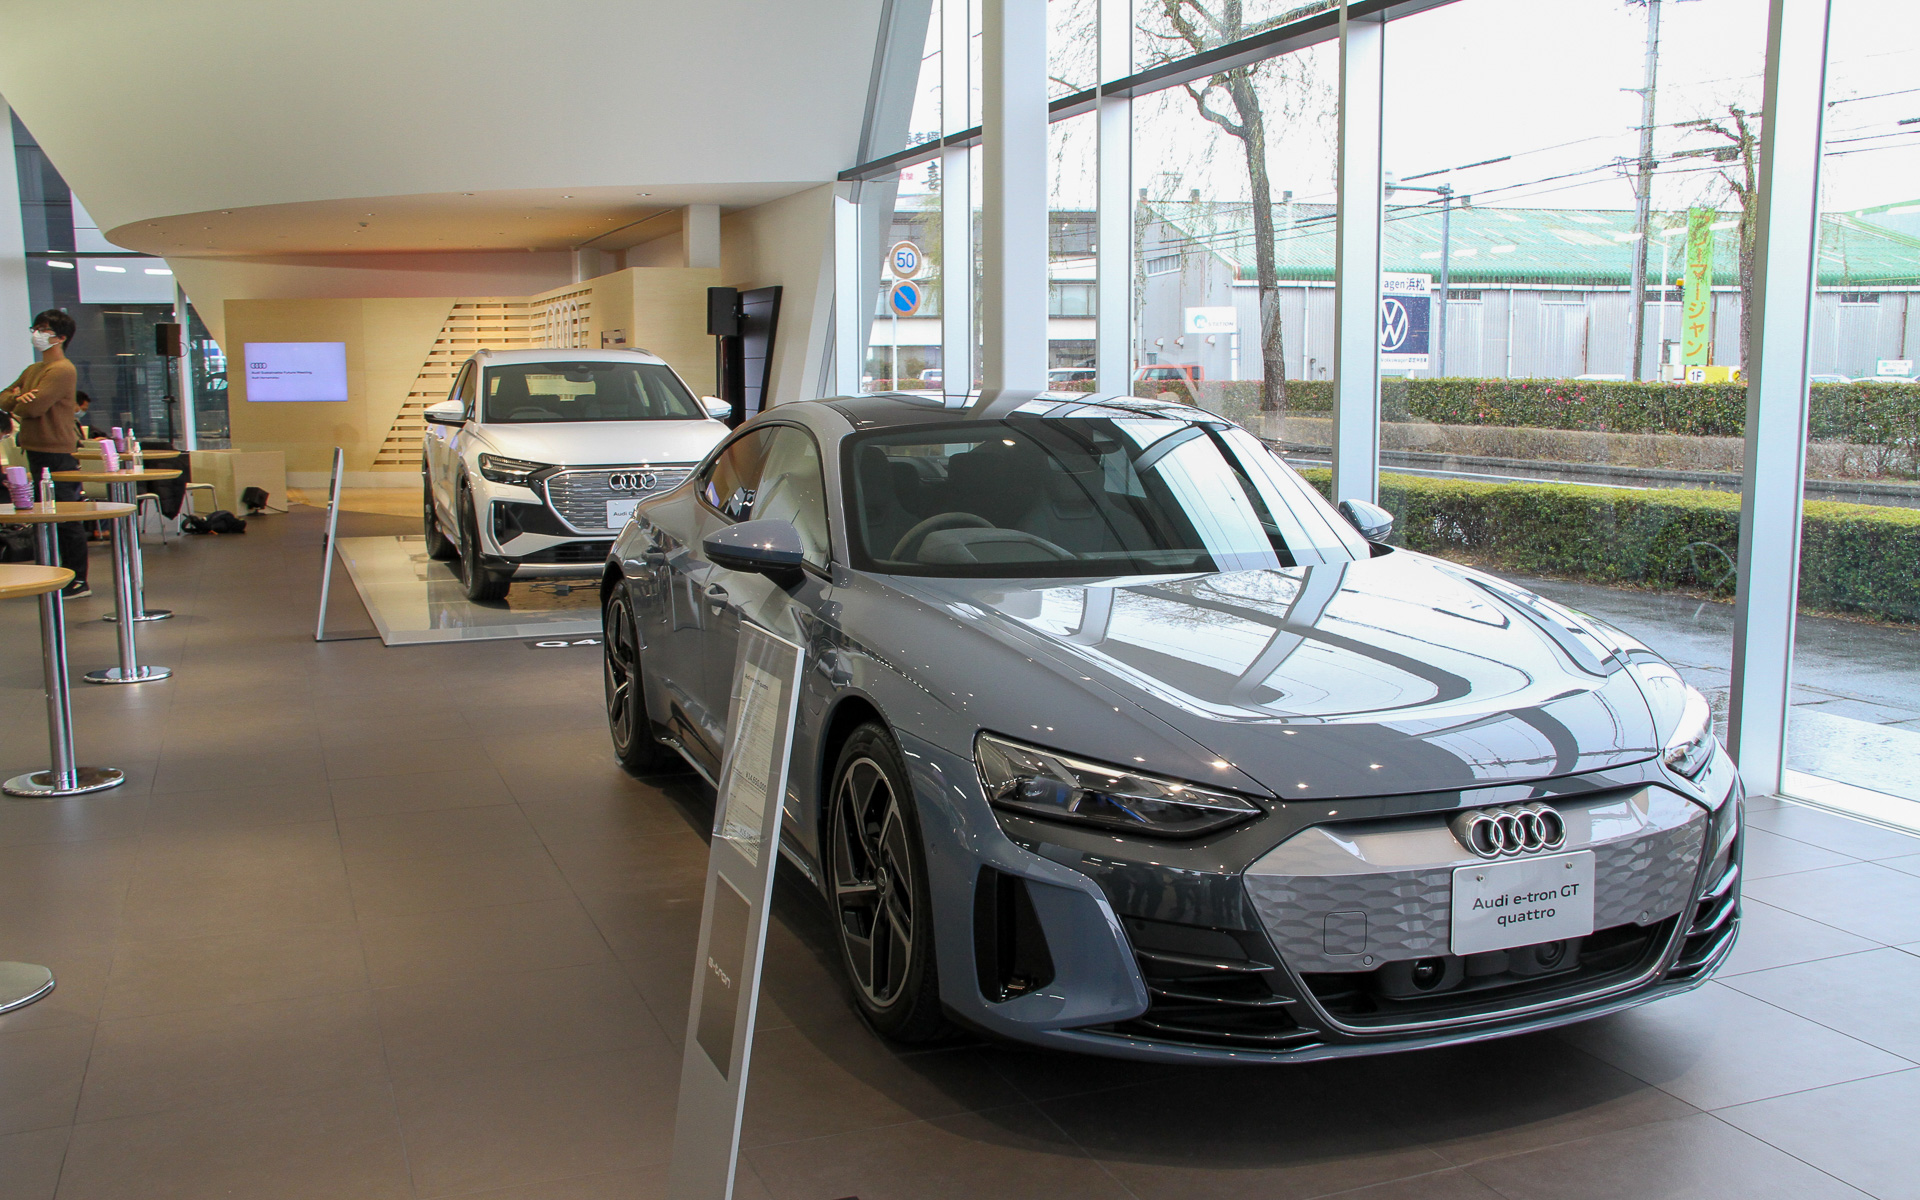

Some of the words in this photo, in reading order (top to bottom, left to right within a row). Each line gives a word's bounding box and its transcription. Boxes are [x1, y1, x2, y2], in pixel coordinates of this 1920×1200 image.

[896, 251, 915, 268] 50
[1692, 371, 1702, 381] 1F
[536, 639, 602, 648] Q4
[1472, 894, 1508, 910] Audi
[1513, 890, 1557, 905] e-tron
[1560, 883, 1579, 898] GT
[1497, 908, 1556, 928] quattro
[708, 956, 731, 989] e-tron
